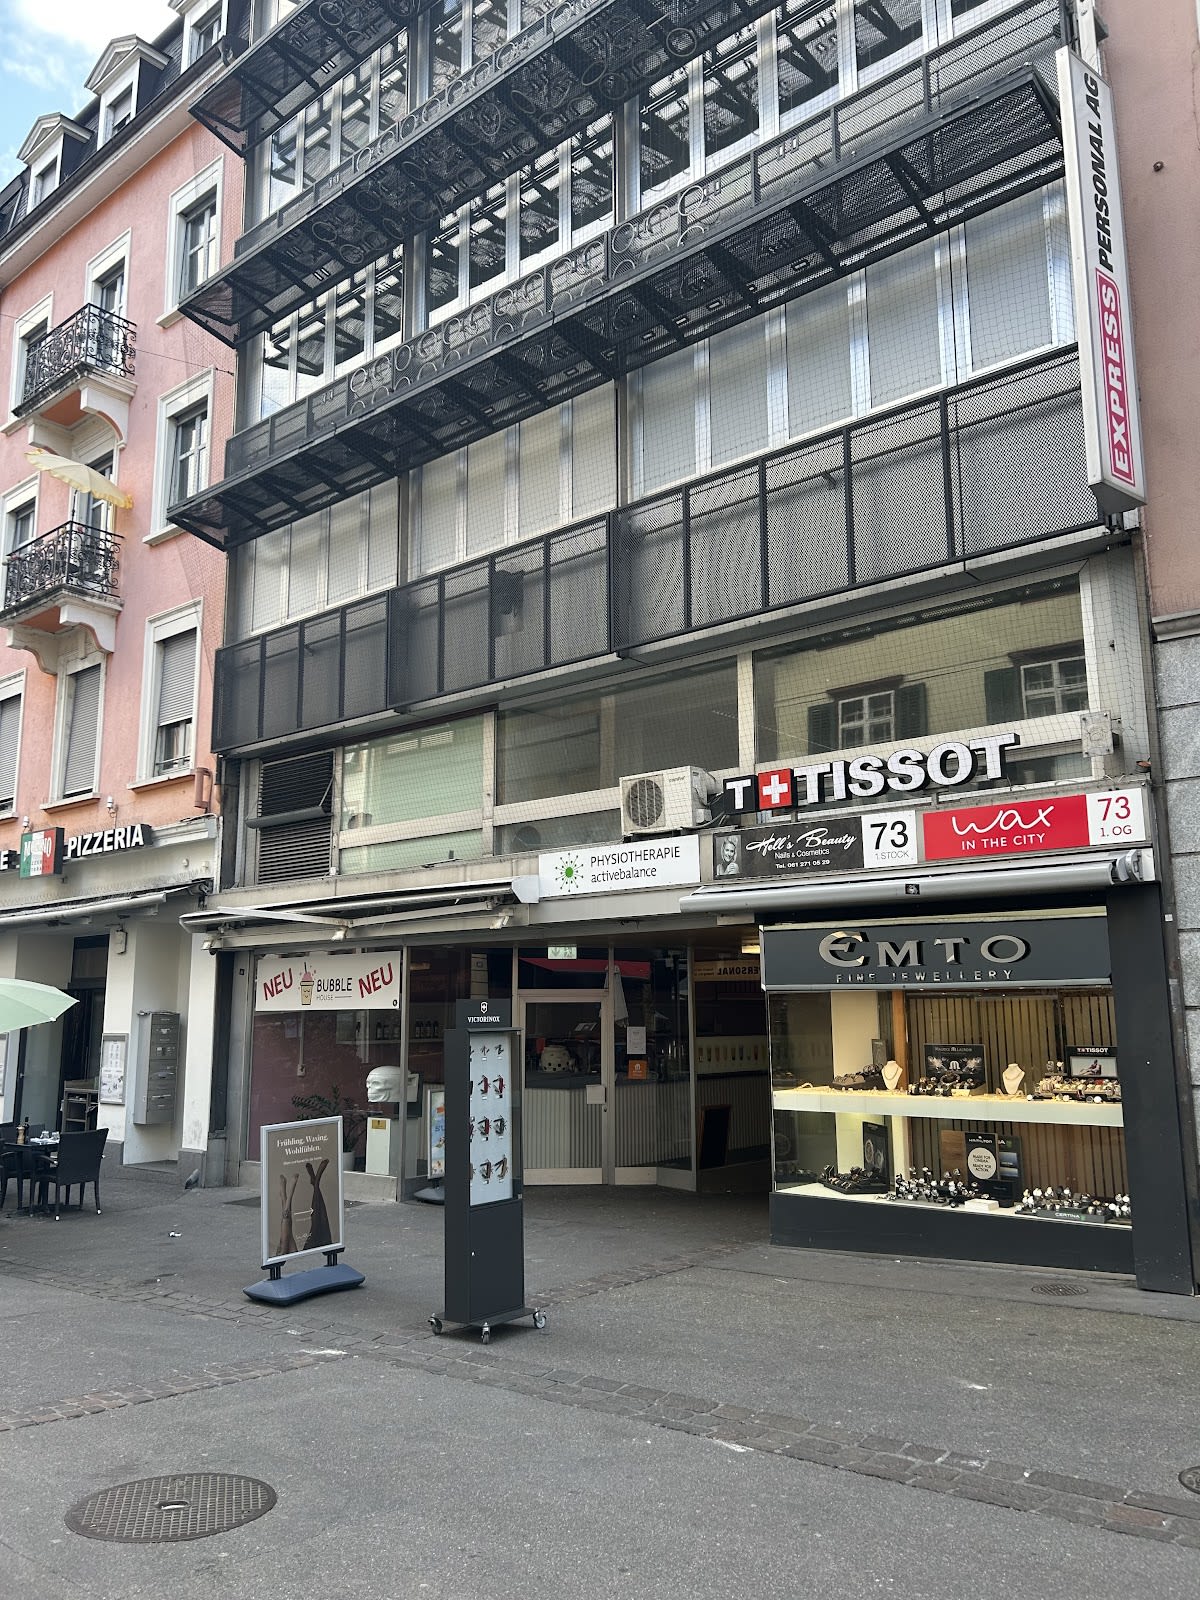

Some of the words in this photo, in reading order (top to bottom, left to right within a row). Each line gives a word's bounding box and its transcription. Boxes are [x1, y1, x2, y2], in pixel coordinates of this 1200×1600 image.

[1084, 72, 1101, 120] AG
[1088, 120, 1114, 274] PERSONAL
[1102, 284, 1129, 473] EXPRESS
[794, 733, 1018, 804] TISSOT
[952, 805, 1055, 836] wax
[1097, 796, 1131, 821] 73
[67, 823, 144, 858] PIZZERIA
[745, 832, 795, 856] Hell's
[797, 828, 858, 850] Beauty
[870, 820, 909, 850] 73
[961, 839, 976, 850] IN
[981, 836, 1008, 848] THE
[1013, 833, 1045, 846] CITY
[1112, 825, 1132, 836] OG
[590, 846, 681, 868] PHYSIOTHERAPIE
[774, 851, 790, 860] Nails
[796, 848, 830, 859] Cosmetics
[591, 866, 657, 883] activebalance
[818, 930, 1029, 967] EMTO
[263, 967, 294, 1001] NEU
[316, 977, 353, 992] BUBBLE
[358, 962, 394, 999] NEU
[836, 973, 876, 984] FINE
[892, 969, 1013, 982] JEWELLERY
[467, 1015, 501, 1023] VICTORINOX
